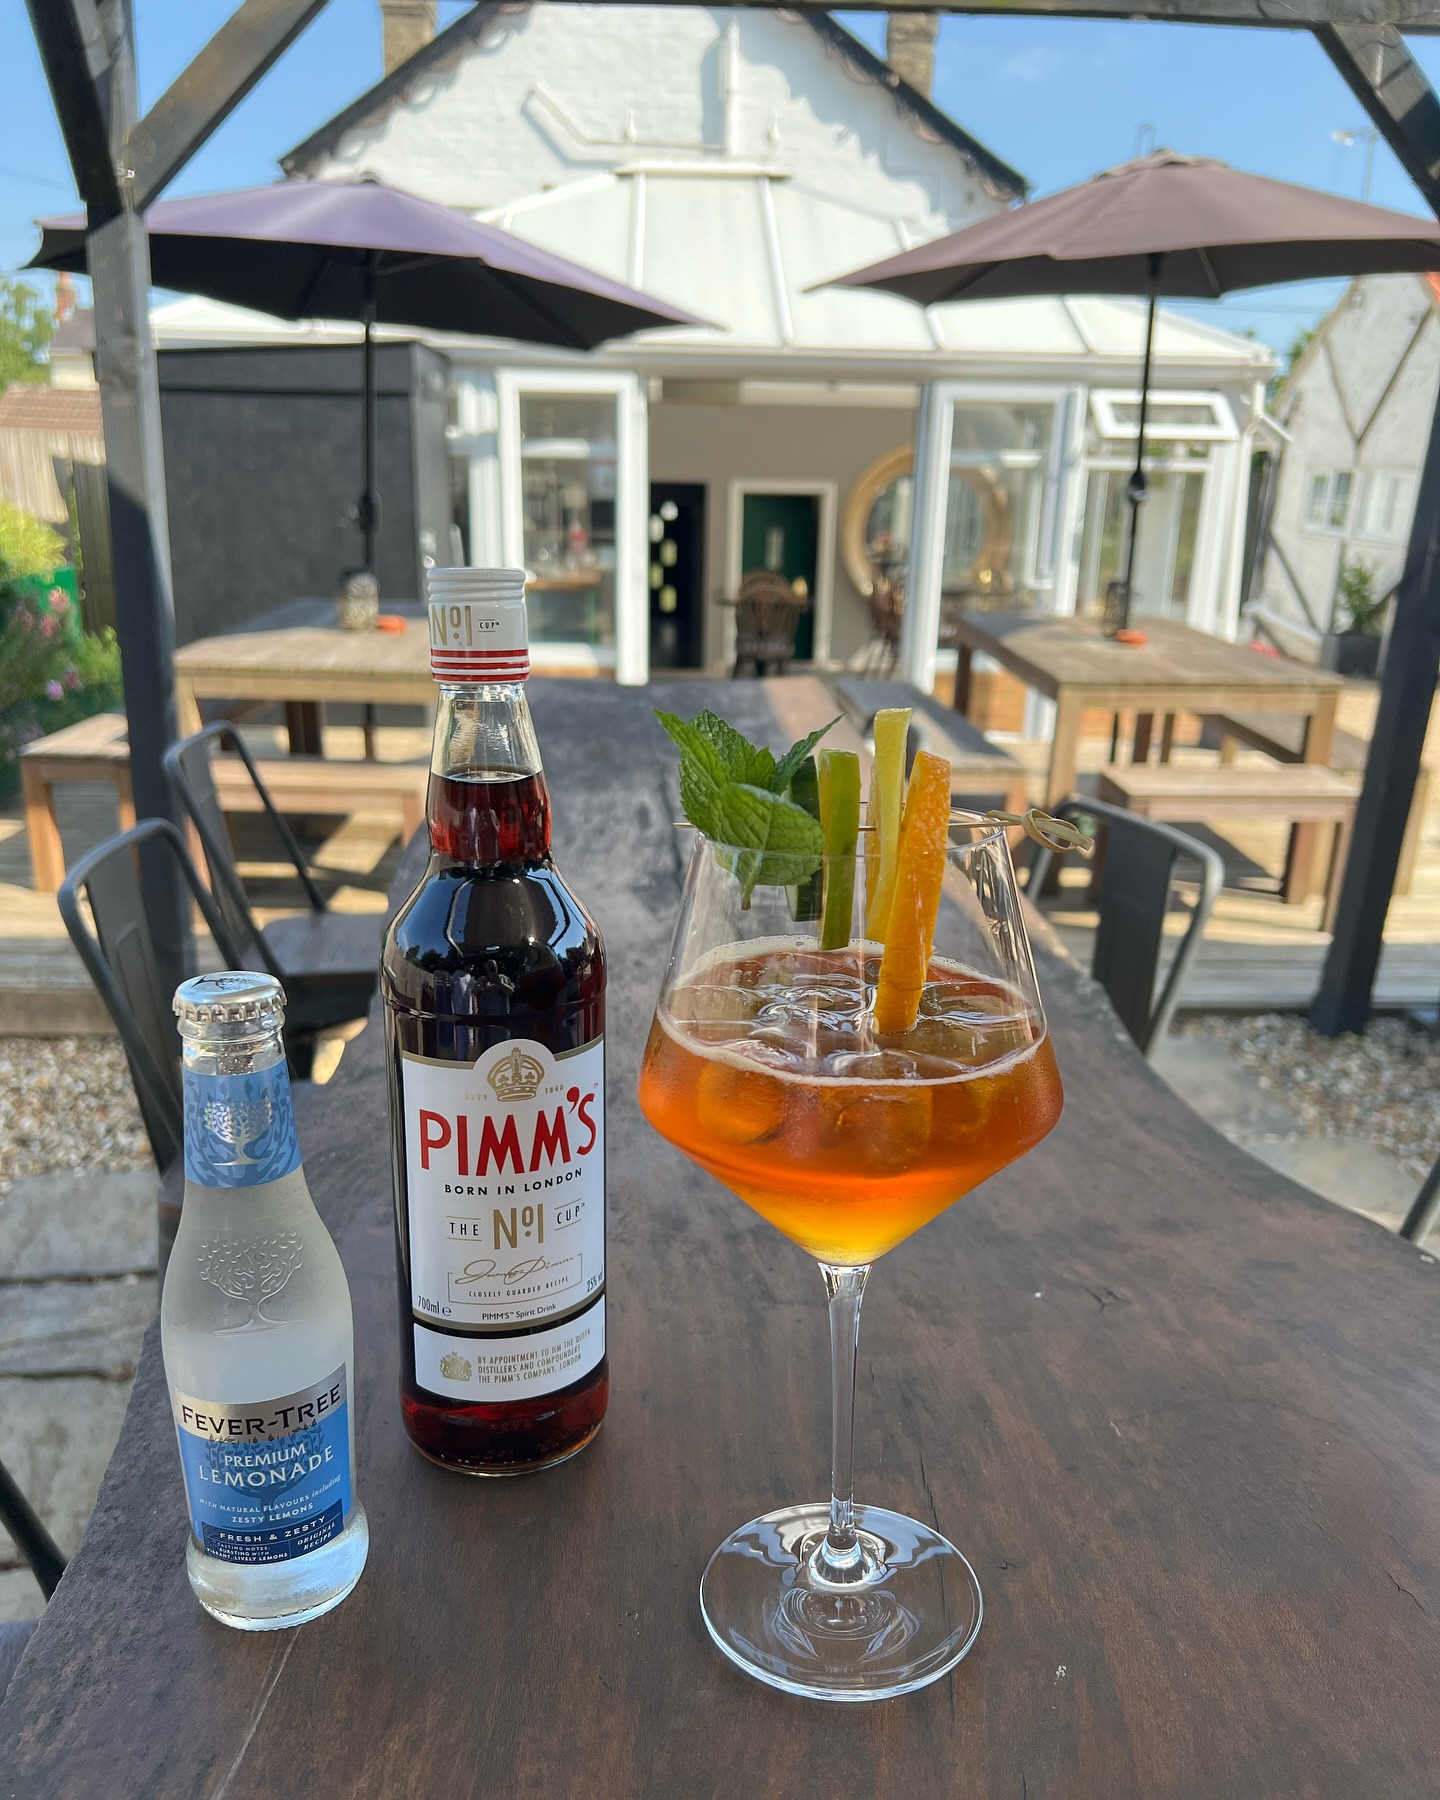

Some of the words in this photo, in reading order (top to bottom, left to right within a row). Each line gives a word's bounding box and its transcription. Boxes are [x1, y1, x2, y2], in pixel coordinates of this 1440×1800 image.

[444, 1184, 488, 1196] BORN
[497, 1185, 515, 1195] IN
[524, 1167, 582, 1192] LONDON
[449, 1222, 479, 1236] THE
[468, 1290, 502, 1298] CLOSELY
[506, 1285, 541, 1297] GUARDED
[545, 1276, 569, 1289] RECIPE
[586, 1276, 597, 1293] 25%
[417, 1295, 440, 1315] 700ml
[515, 1309, 536, 1319] Spirit
[537, 1303, 557, 1315] Drink
[477, 1356, 487, 1364] BY
[490, 1351, 538, 1364] APPOINTMENT
[541, 1348, 549, 1357] TO
[552, 1344, 561, 1353] HM
[564, 1338, 574, 1348] THE
[576, 1328, 591, 1343] QUEEN
[477, 1375, 491, 1383] THE
[494, 1373, 521, 1383] PIMM'S
[524, 1366, 557, 1380] COMPANY,
[560, 1354, 581, 1370] LONDON
[478, 1365, 517, 1374] DISTILLERS
[520, 1361, 534, 1371] AND
[538, 1345, 581, 1367] COMPOUNDERS
[182, 1383, 341, 1436] FEVER-TREE
[199, 1445, 334, 1487] LEMONADE
[225, 1443, 306, 1467] PREMIUM
[199, 1498, 217, 1509] WITH
[219, 1504, 260, 1513] NATURAL
[263, 1494, 310, 1512] FLAVOURS
[312, 1473, 342, 1498] including
[231, 1515, 265, 1523] ZESTY
[269, 1502, 314, 1521] LEMONS
[219, 1532, 262, 1542] FRESH
[269, 1533, 278, 1541] &
[284, 1515, 326, 1537] ZESTY
[297, 1522, 336, 1545] ORIGINAL
[217, 1543, 243, 1551] TASTING
[219, 1548, 250, 1556] BURSTING
[303, 1532, 332, 1550] RECIPE
[259, 1553, 288, 1561] LEMONS
